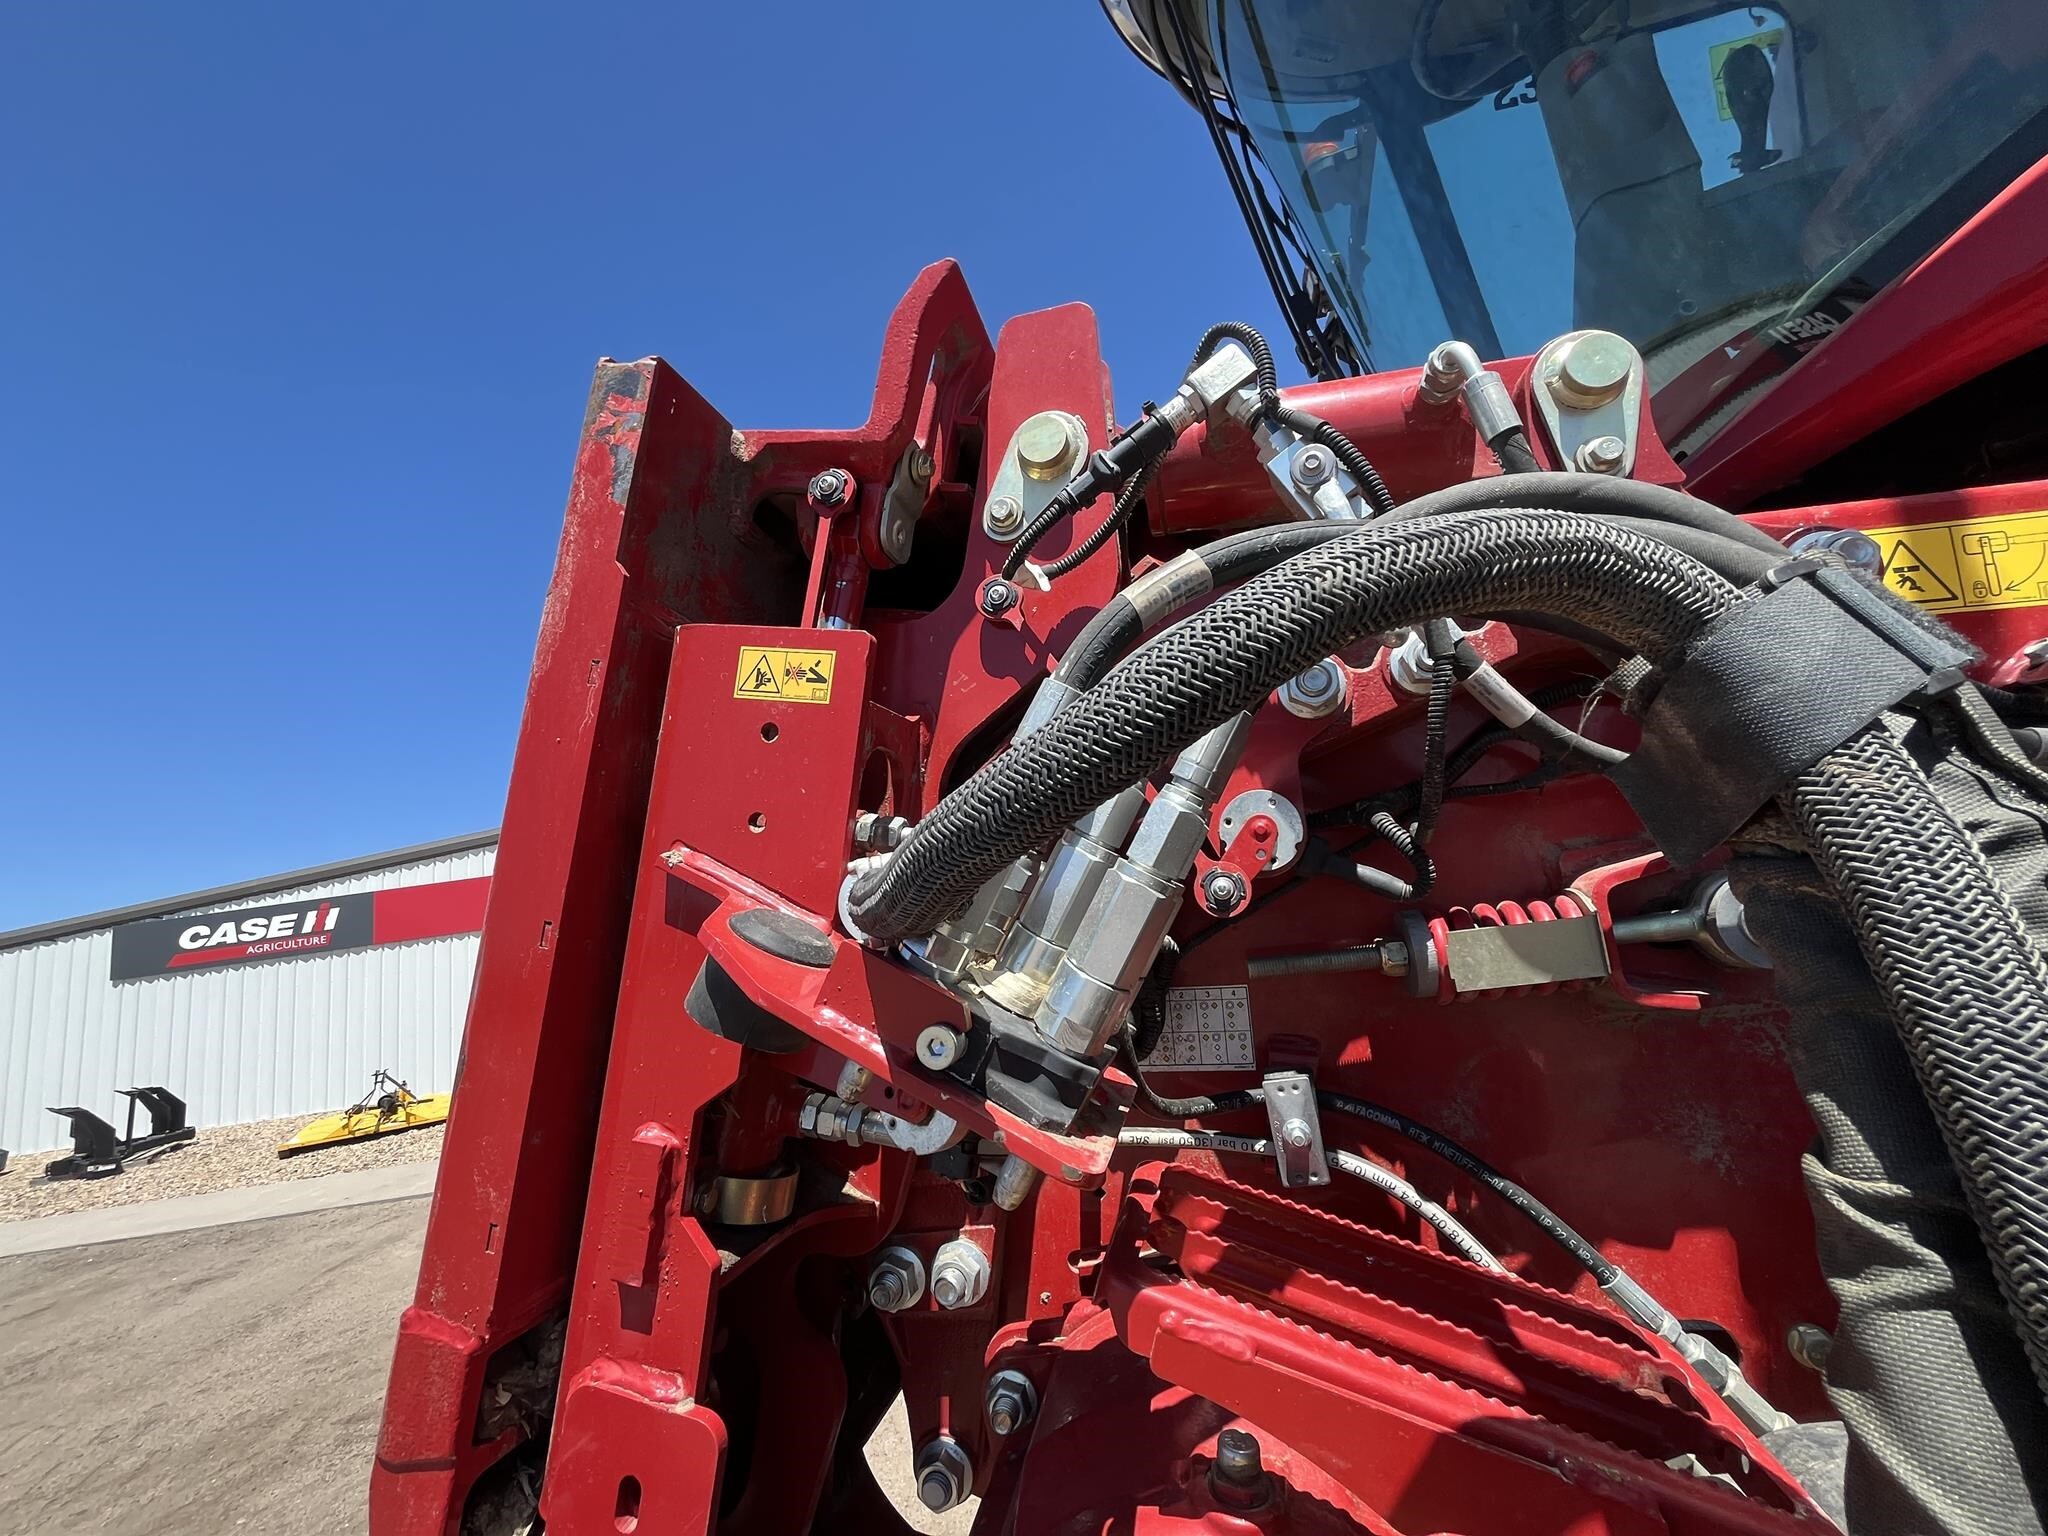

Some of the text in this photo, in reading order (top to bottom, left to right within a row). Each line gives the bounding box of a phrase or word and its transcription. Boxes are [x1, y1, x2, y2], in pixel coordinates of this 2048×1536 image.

[178, 912, 299, 950] CASE
[246, 935, 328, 955] AGRICULTURE
[1178, 989, 1237, 999] 2 3 4
[1129, 1134, 1150, 1145] SAE
[1157, 1135, 1175, 1145] psi)
[1178, 1135, 1213, 1148] (3050
[1217, 1137, 1237, 1149] bar
[1331, 1156, 1368, 1178] (0.25
[1372, 1172, 1398, 1192] mm
[1400, 1191, 1424, 1210] 6.4
